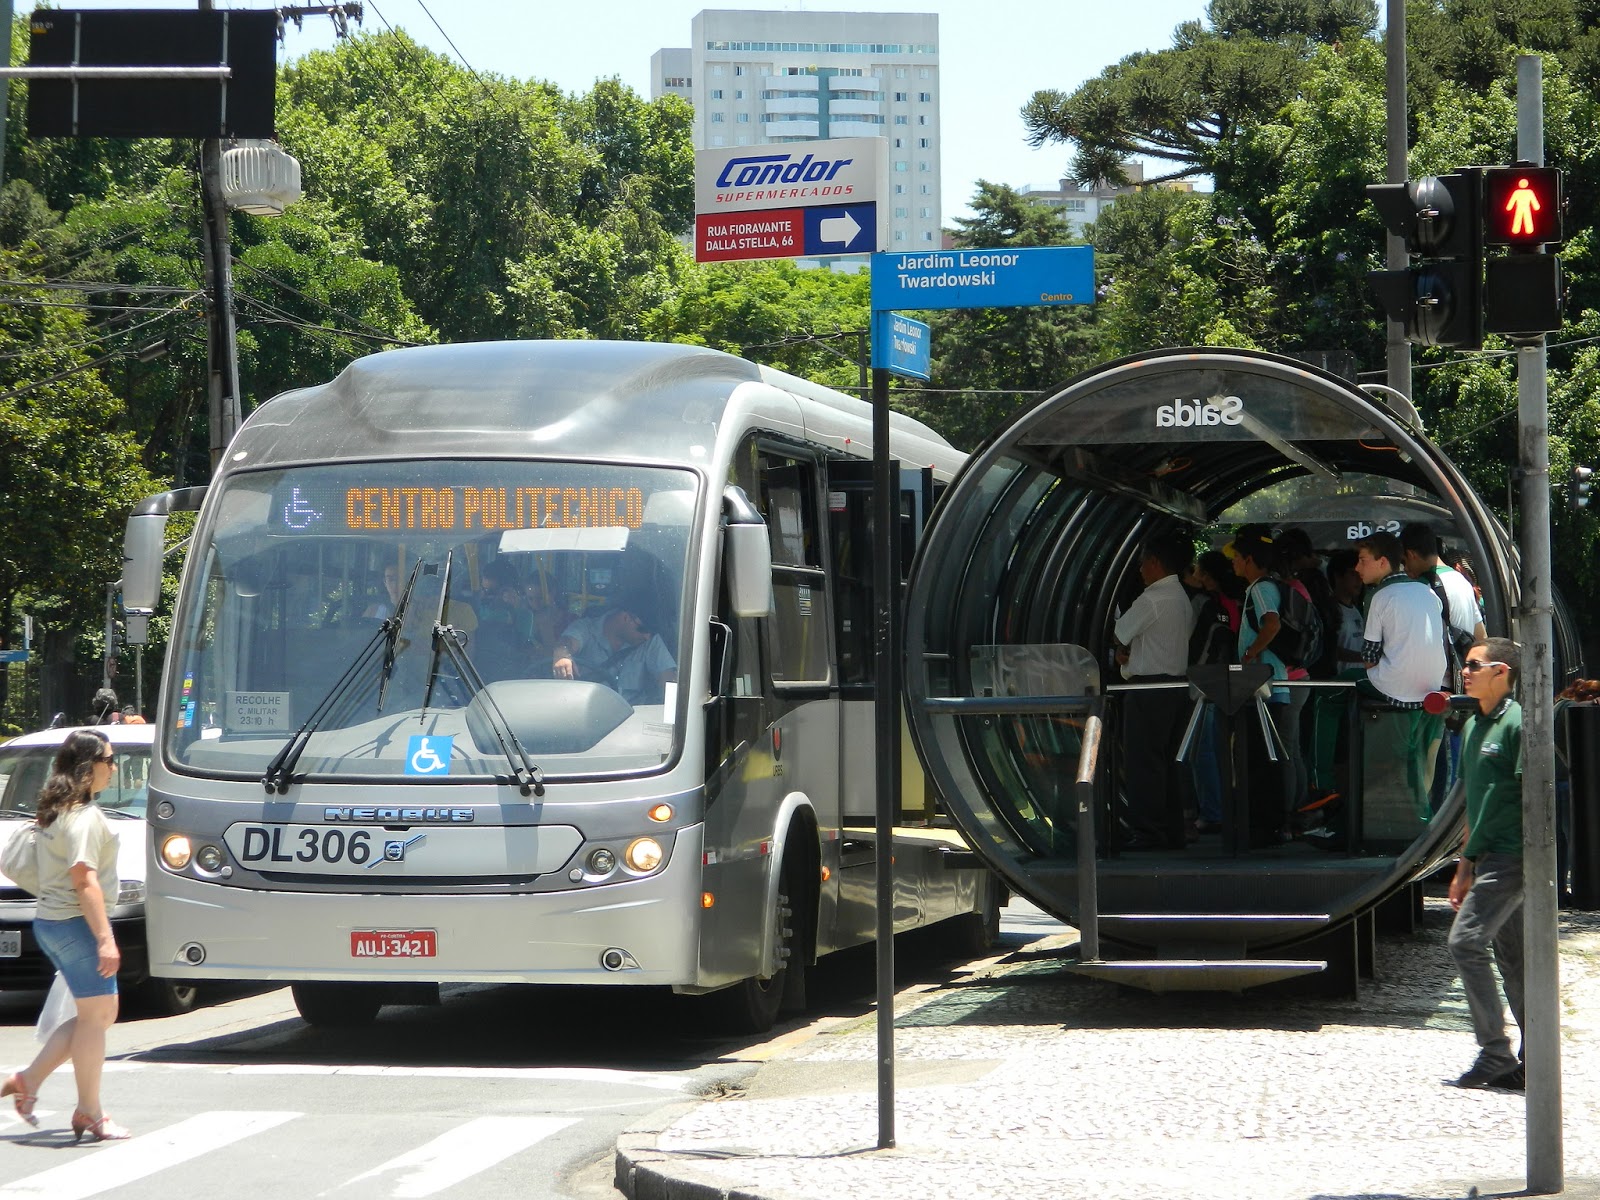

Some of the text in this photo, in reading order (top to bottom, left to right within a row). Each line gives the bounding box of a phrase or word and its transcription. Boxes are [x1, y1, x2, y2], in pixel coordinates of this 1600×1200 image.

[716, 154, 853, 188] Condor
[716, 185, 854, 202] SUPERMERCADOS
[707, 221, 792, 237] RUA FIORAVANTE
[706, 236, 793, 251] DALLA STELLA, 66
[897, 252, 1019, 270] Jardim Leonor
[897, 271, 995, 289] Twardowski
[1040, 293, 1073, 302] Centro
[907, 321, 922, 339] Leonor
[346, 487, 643, 529] CENTRO POLITECNICO
[235, 695, 281, 705] RECOLHE
[247, 707, 278, 715] MILITAR
[268, 717, 274, 726] h
[324, 807, 475, 822] NEOBUS
[242, 827, 371, 865] DL306
